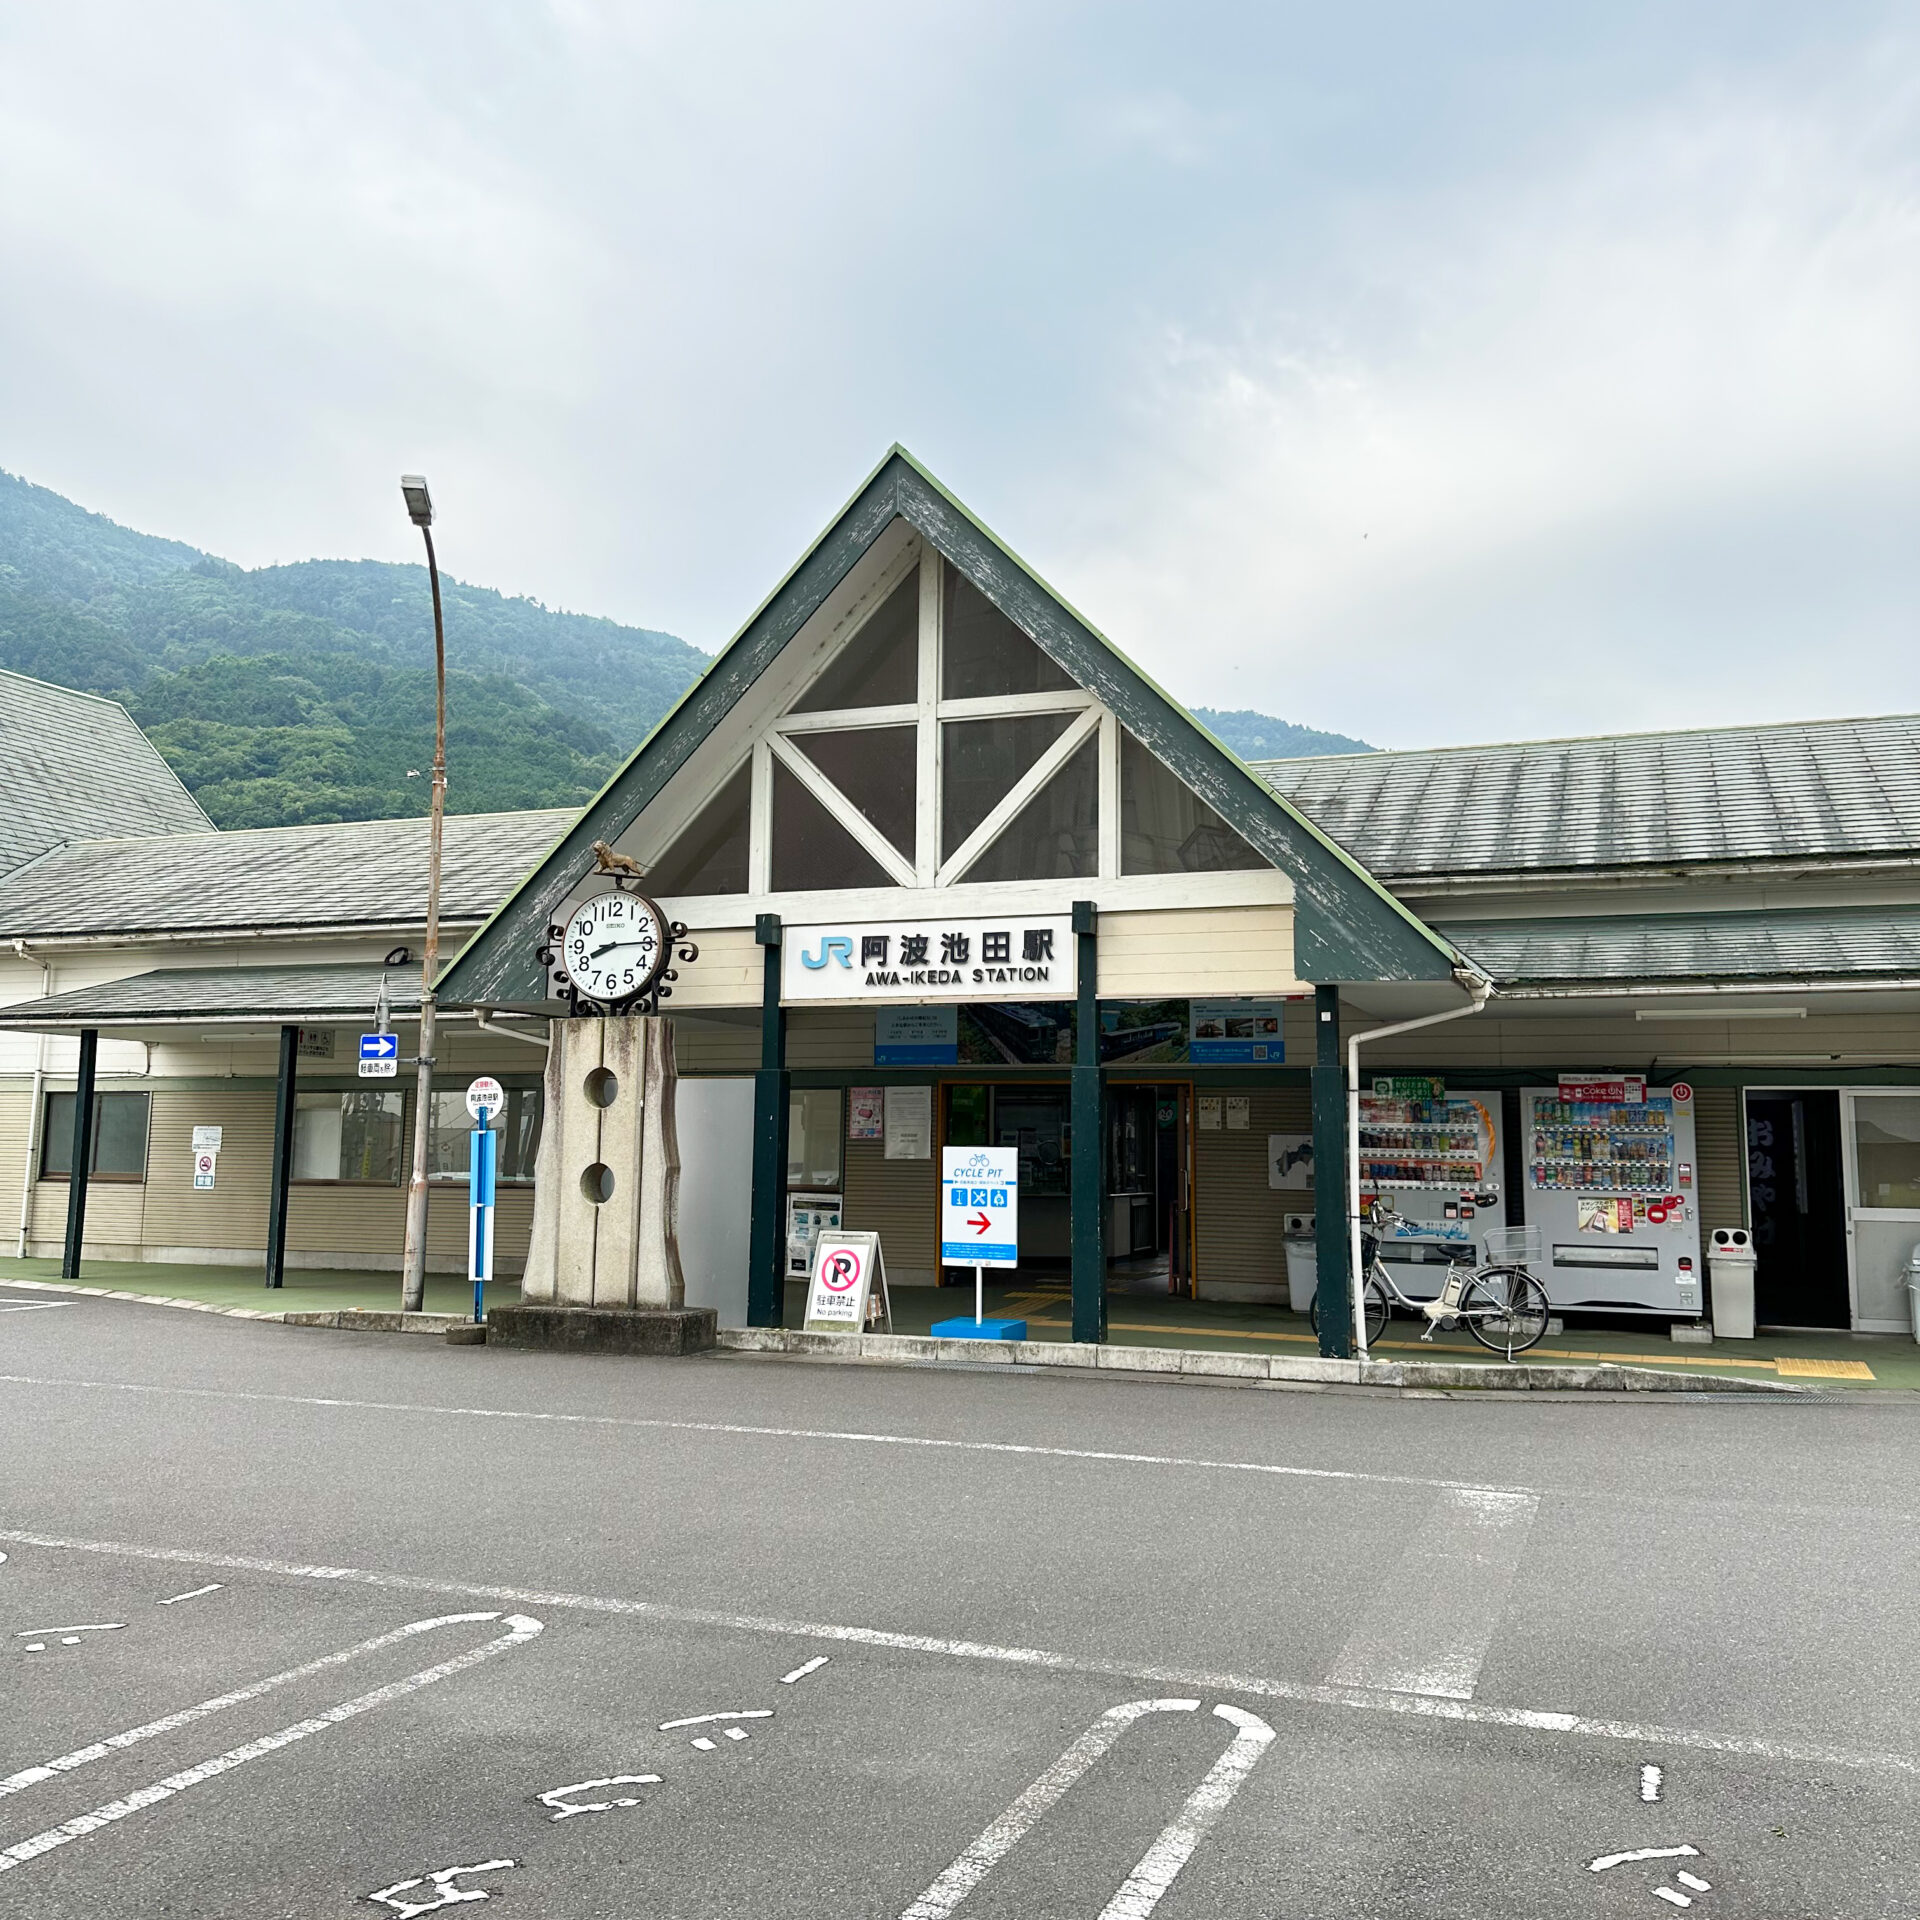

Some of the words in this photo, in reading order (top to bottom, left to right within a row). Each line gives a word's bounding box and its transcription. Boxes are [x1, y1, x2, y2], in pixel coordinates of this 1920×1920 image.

[594, 907, 605, 922] 11
[608, 901, 623, 918] 12
[630, 905, 634, 920] 1
[579, 921, 593, 937] 10
[638, 917, 649, 933] 2
[574, 939, 584, 954] 9
[642, 936, 653, 952] 3
[801, 936, 853, 970] JR
[861, 929, 1055, 967] 阿波池田駅
[579, 956, 589, 971] 8
[636, 955, 647, 970] 4
[592, 971, 602, 986] 7
[606, 974, 617, 990] 6
[623, 969, 634, 985] 5
[865, 969, 962, 986] AWA-IKEDA
[972, 966, 1049, 983] STATION
[1583, 1087, 1607, 1095] Coke
[954, 1168, 984, 1178] CYCLE
[987, 1169, 1003, 1178] PIT
[816, 1294, 856, 1307] 駐車禁止
[828, 1308, 853, 1317] parking
